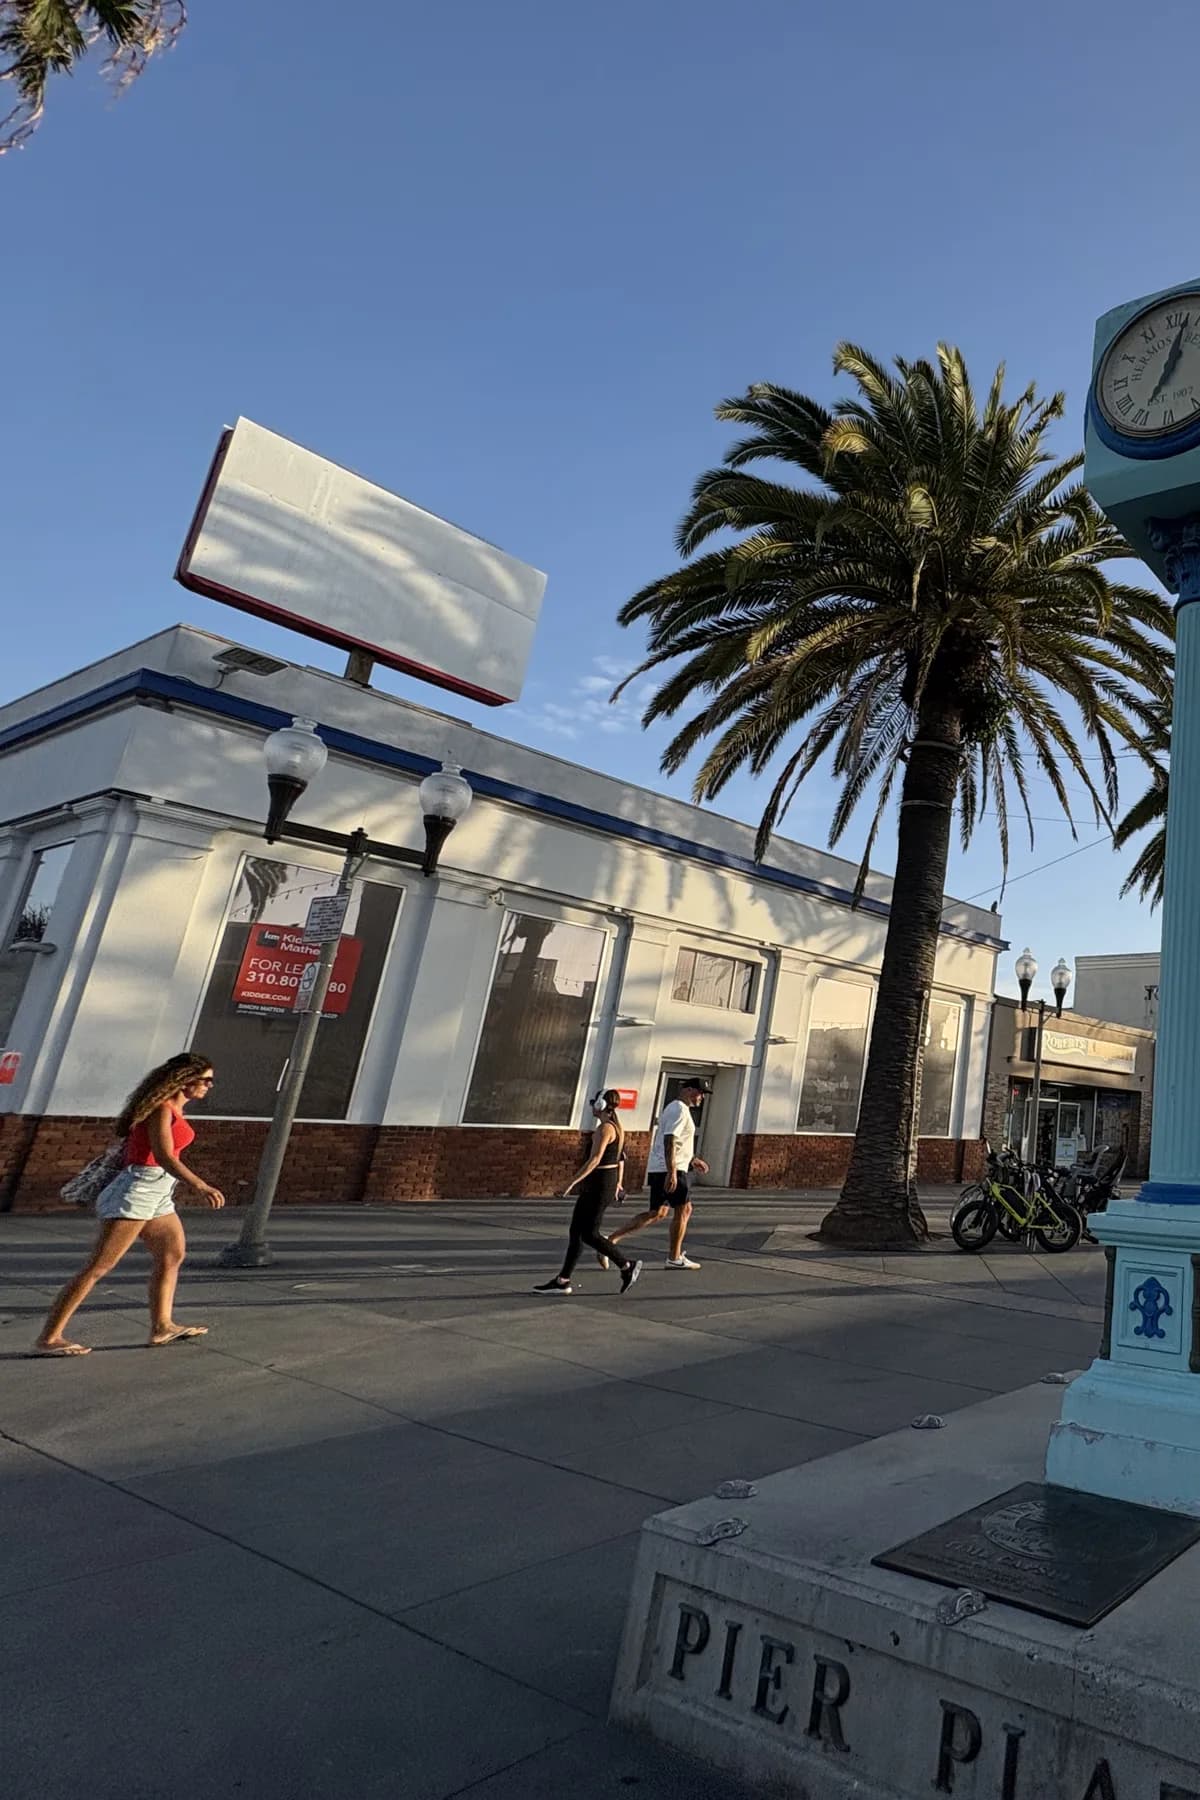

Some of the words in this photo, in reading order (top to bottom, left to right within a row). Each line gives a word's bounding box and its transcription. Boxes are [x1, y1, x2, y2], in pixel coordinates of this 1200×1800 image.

[1140, 327, 1157, 344] XI
[1122, 353, 1137, 363] X
[1131, 337, 1173, 382] HERMOS
[1113, 376, 1129, 392] IX
[1131, 408, 1150, 426] VII
[1162, 409, 1175, 426] VI
[280, 942, 321, 956] Mathe
[249, 957, 281, 972] FOR
[667, 1601, 852, 1752] PIER
